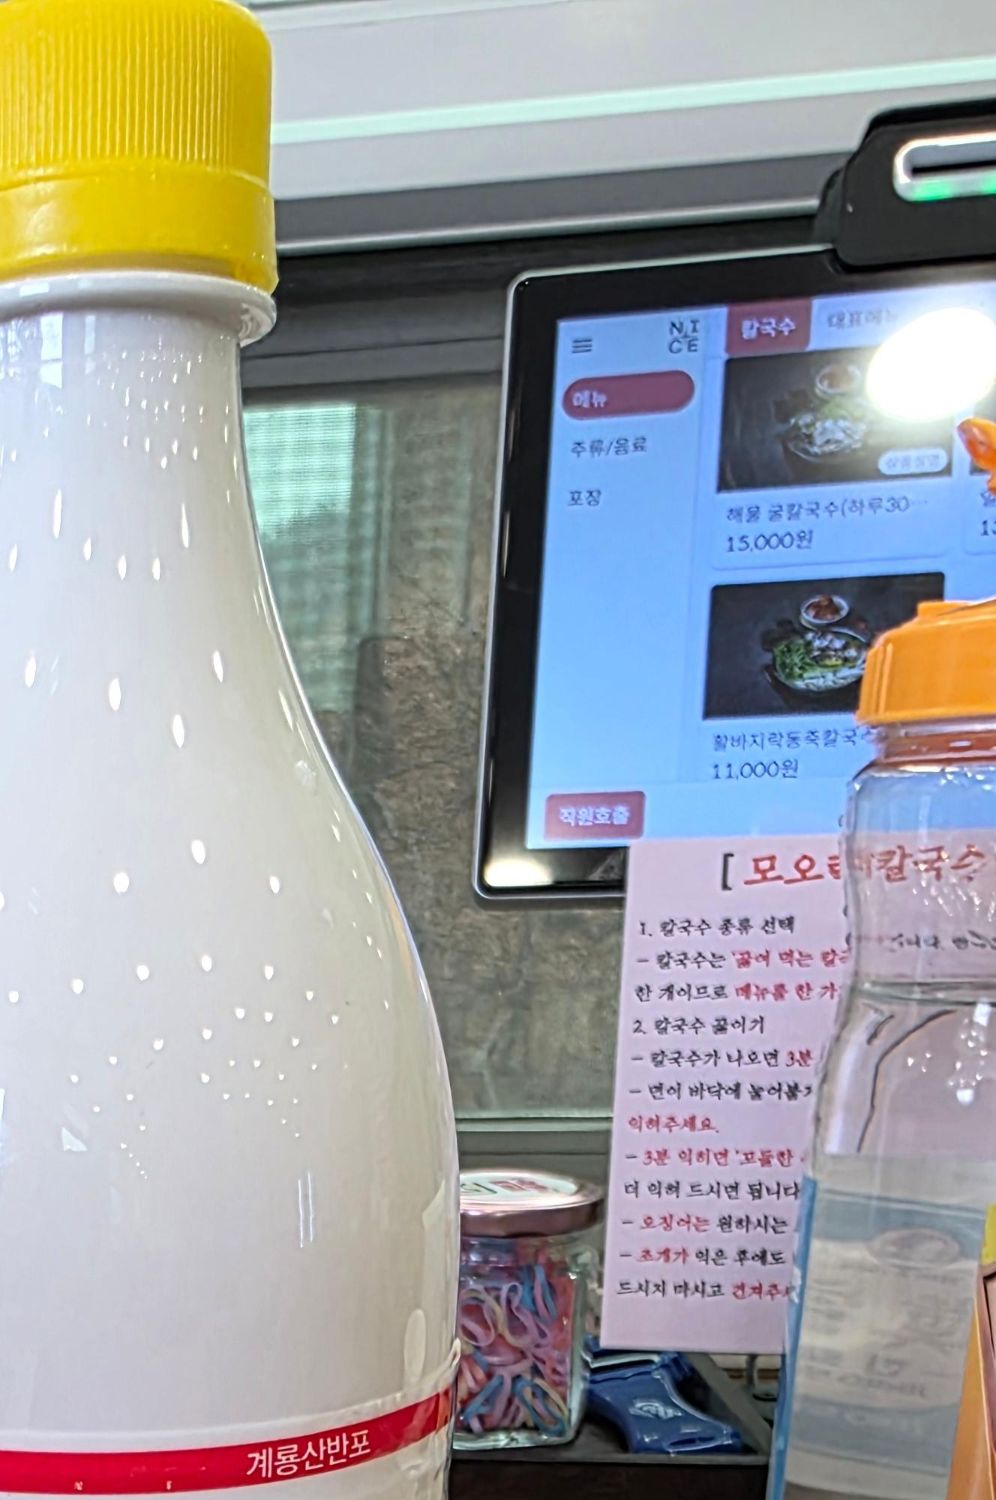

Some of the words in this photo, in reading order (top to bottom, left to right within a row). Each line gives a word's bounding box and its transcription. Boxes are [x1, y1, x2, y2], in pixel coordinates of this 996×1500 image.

[741, 316, 796, 340] 칼국수
[572, 389, 607, 408] 메뉴
[571, 436, 648, 458] 주류/음료
[568, 488, 602, 507] 포장
[727, 503, 761, 523] 해물
[727, 529, 813, 552] 15,000원
[713, 758, 799, 780] 11,000원
[560, 804, 631, 827] 직원호출
[660, 918, 712, 937] 칼국수
[718, 917, 754, 935] 종류
[760, 916, 795, 935] 선택
[657, 949, 726, 970] 칼국수는
[779, 949, 814, 968] 먹는
[635, 983, 653, 1002] 한
[734, 982, 788, 1002] 메뉴를
[795, 981, 812, 1001] 한
[654, 1015, 706, 1035] 칼국수
[651, 1049, 721, 1068] 칼국수가
[726, 1048, 780, 1069] 나오면
[785, 1048, 814, 1068] 3분
[648, 1082, 682, 1101] 면이
[688, 1080, 741, 1100] 바닥에
[628, 1115, 719, 1134] 익혀주세요.
[643, 1148, 671, 1166] 3분
[678, 1148, 730, 1167] 익히면
[623, 1180, 640, 1199] 더
[647, 1180, 681, 1199] 익혀
[686, 1181, 740, 1200] 드시면
[640, 1213, 711, 1233] 오징어는
[716, 1214, 788, 1235] 원하시는
[636, 1247, 689, 1265] 조개가
[695, 1248, 727, 1267] 익은
[733, 1247, 787, 1267] 후에도
[616, 1279, 667, 1298] 드시지
[673, 1279, 725, 1298] 마시고
[246, 1429, 371, 1478] 계룡산반포
